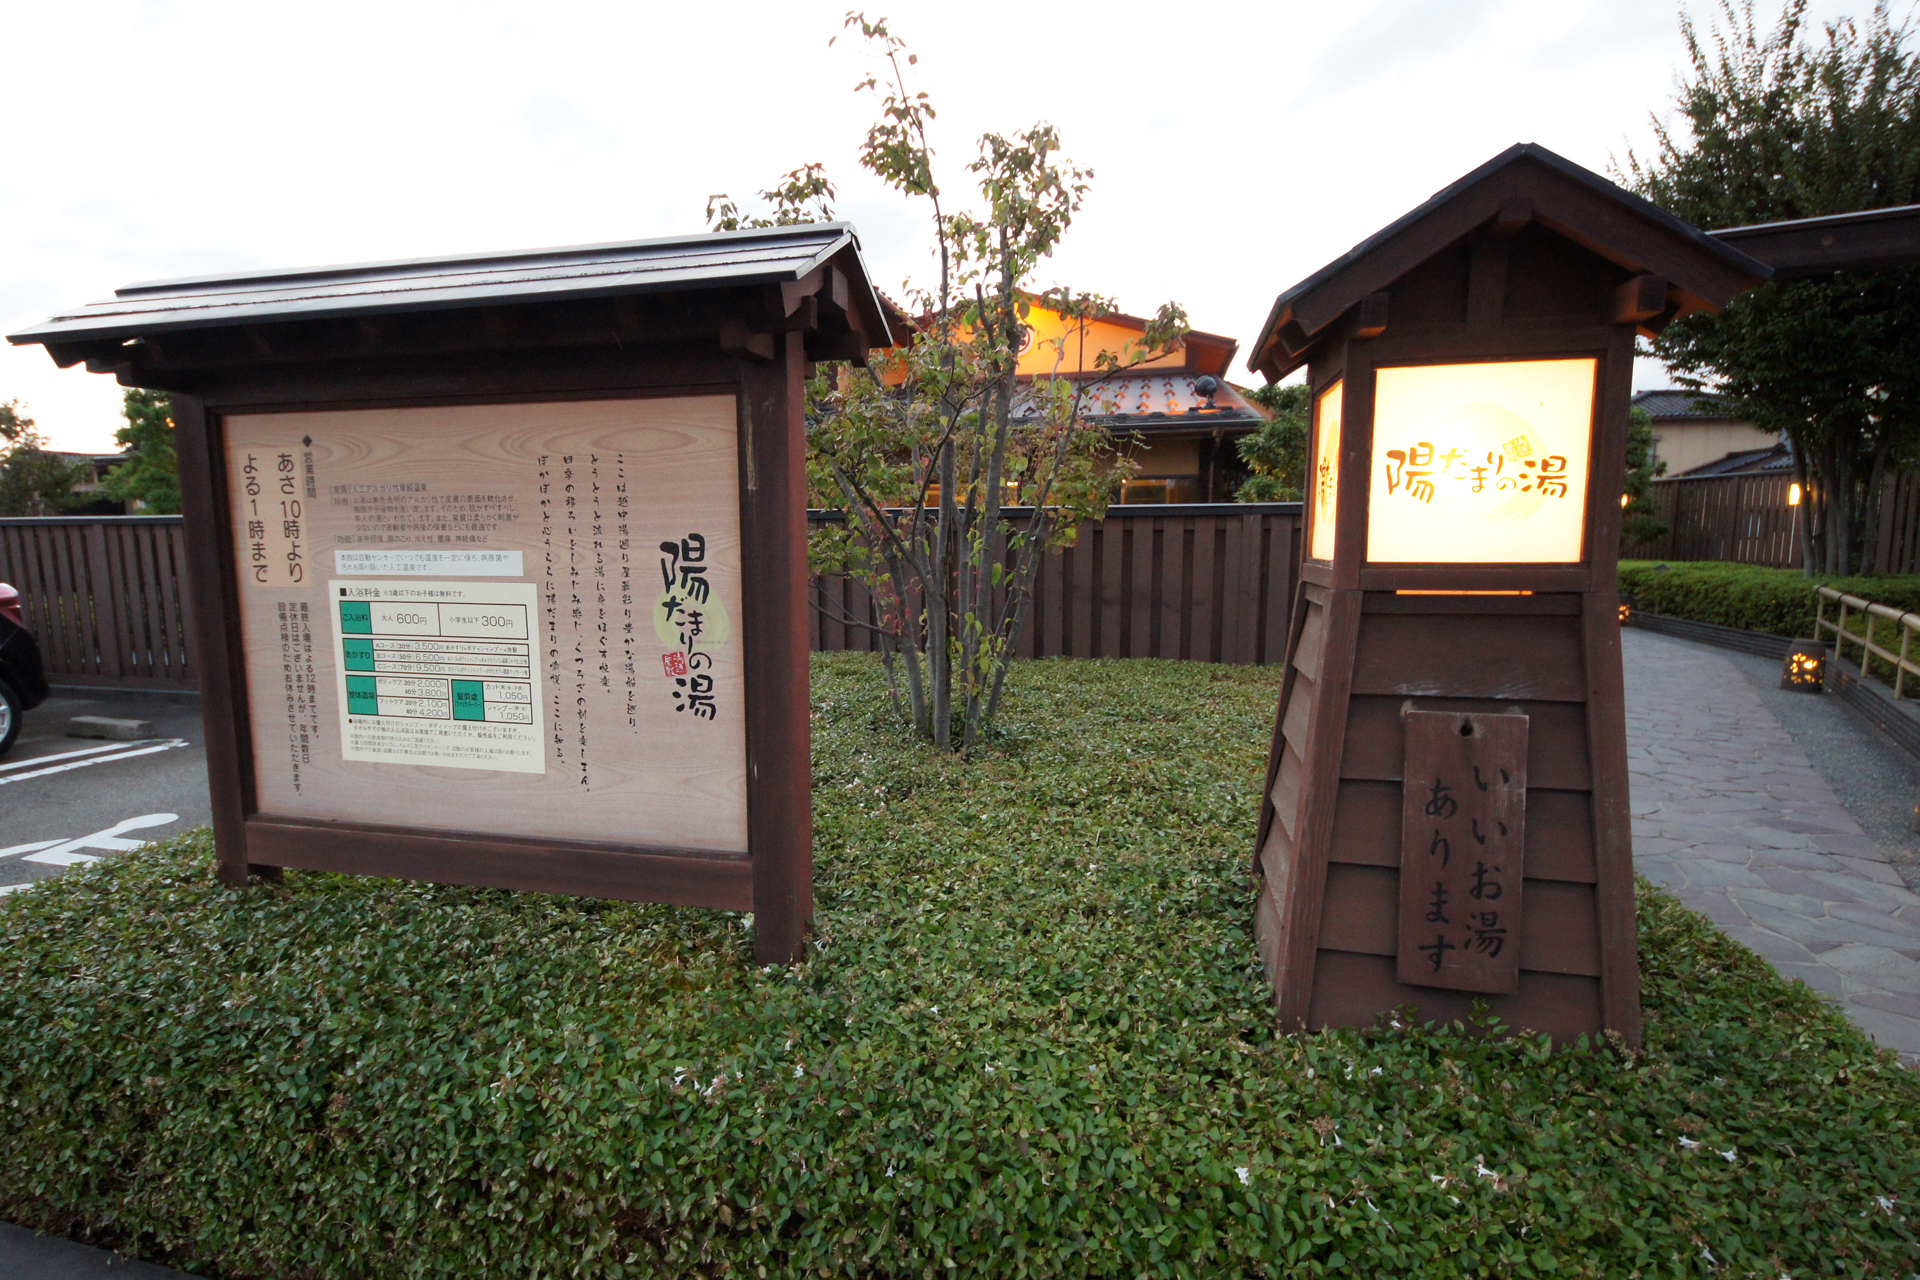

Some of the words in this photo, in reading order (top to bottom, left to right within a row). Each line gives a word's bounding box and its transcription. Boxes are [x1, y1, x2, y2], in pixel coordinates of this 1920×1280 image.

[303, 452, 316, 499] 営業時間
[1386, 442, 1567, 503] 陽だまりの湯
[243, 453, 268, 583] よる1時まで
[277, 453, 303, 583] あさ10時より
[381, 614, 393, 622] 大人
[396, 613, 427, 625] 600円
[481, 616, 513, 628] 300円
[659, 533, 717, 720] 陽だまりの湯
[345, 650, 370, 659] あかすり
[499, 691, 528, 701] 1,050円
[500, 711, 529, 721] 1,050円
[1418, 778, 1458, 973] あります
[1464, 766, 1508, 958] いいお湯
